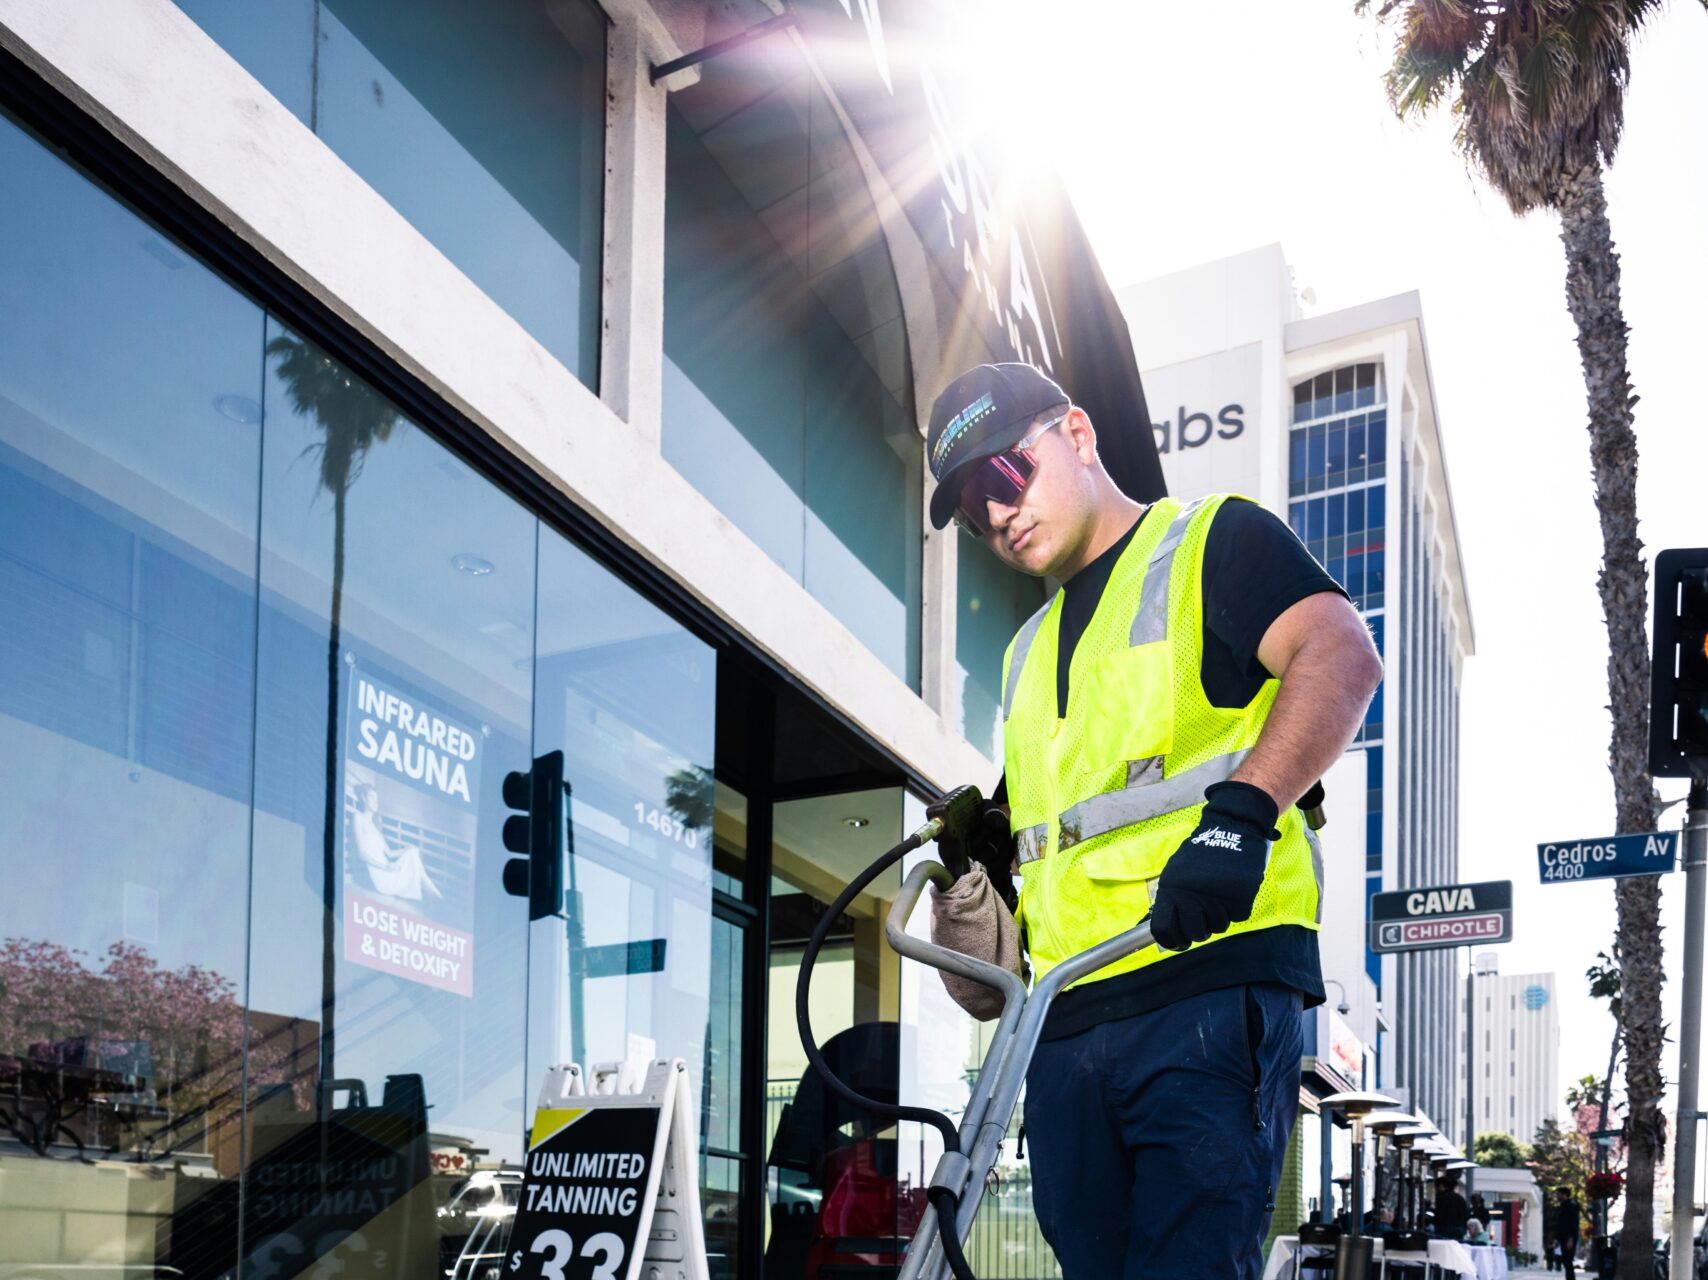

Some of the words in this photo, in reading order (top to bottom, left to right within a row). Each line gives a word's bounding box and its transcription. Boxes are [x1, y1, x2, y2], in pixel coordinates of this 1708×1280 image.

[358, 679, 475, 760] INFRARED
[357, 718, 471, 803] SAUNA
[634, 801, 697, 849] 14670
[1214, 830, 1242, 843] BLUE
[1543, 843, 1617, 866] Cedros
[1643, 835, 1670, 857] Av
[1544, 863, 1584, 880] 4400
[1406, 888, 1476, 915] CAVA
[353, 901, 399, 936] LOSE
[402, 917, 467, 957] WEIGHT
[1407, 919, 1497, 939] CHIPOTLE
[361, 933, 377, 957] &
[380, 938, 460, 982] DETOXIFY
[532, 1152, 645, 1179] UNLIMITED
[526, 1184, 637, 1217] TANNING
